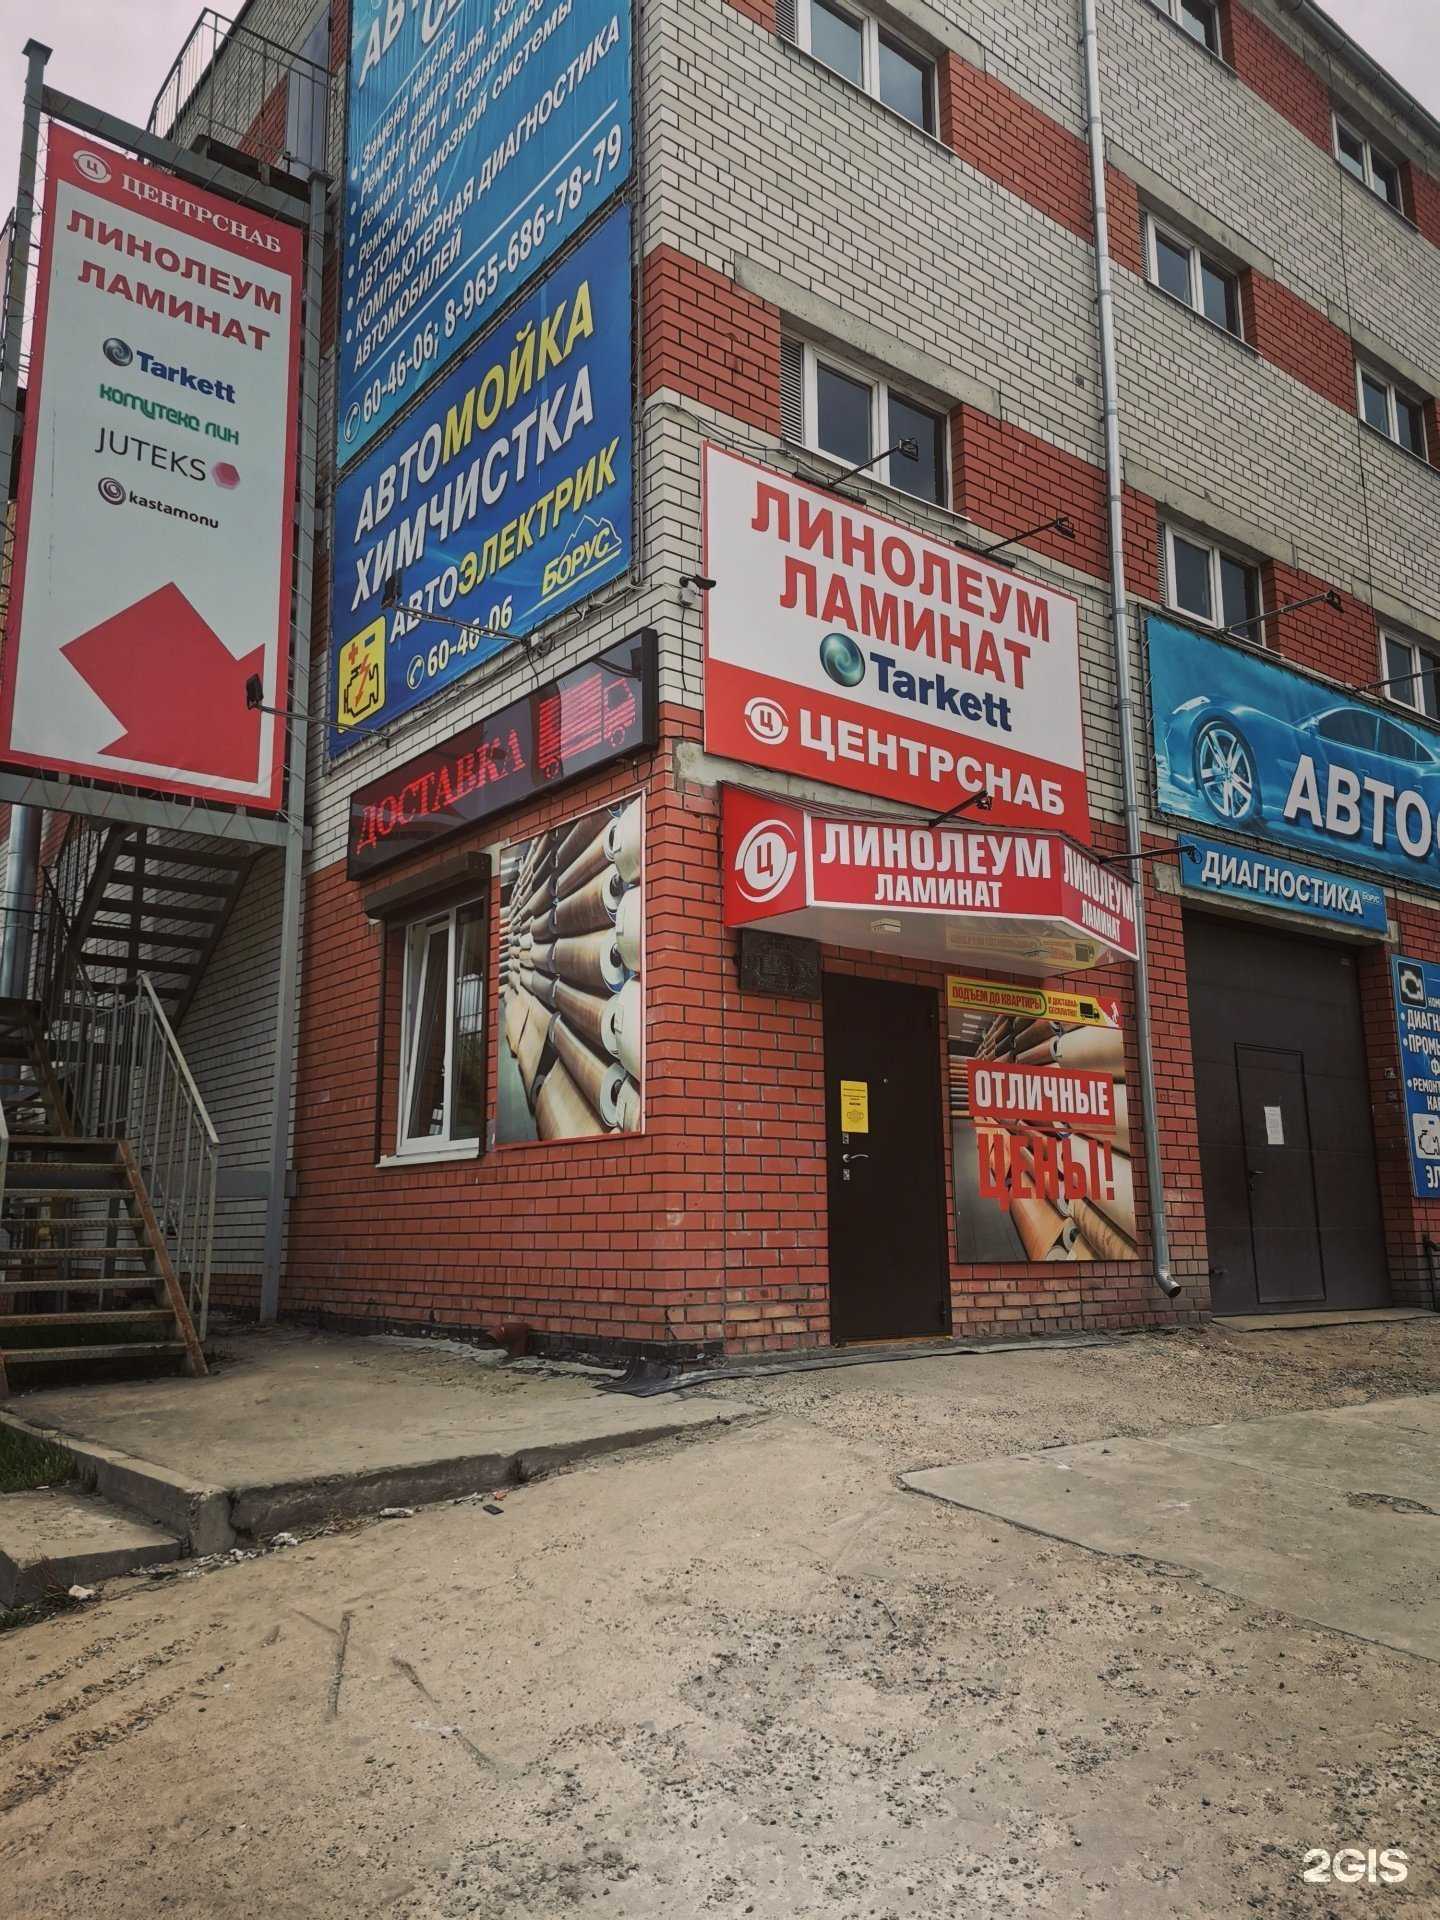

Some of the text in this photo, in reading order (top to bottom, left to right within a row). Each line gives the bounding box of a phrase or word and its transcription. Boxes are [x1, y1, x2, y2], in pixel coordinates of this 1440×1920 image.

[413, 30, 456, 101] масла
[358, 198, 404, 271] Ремонт
[408, 88, 487, 204] тормозной
[492, 0, 573, 99] системы
[361, 129, 407, 204] Ремонт
[409, 26, 487, 142] двигателя,
[356, 15, 620, 337] КОМПЬЮТЕРНАЯ ДИАГНОСТИКА
[360, 163, 405, 237] Ремонт
[409, 114, 437, 172] КПП
[440, 104, 450, 128] и
[121, 173, 281, 253] ЦЕНТРСНАБ
[356, 184, 438, 304] АВТОМОЙКА
[67, 210, 282, 315] ЛИНОЛЕУМ
[354, 224, 462, 373] АВТОМОБИЛЕЙ
[364, 124, 622, 422] 60-46-06; 8-965-686-78-79
[78, 260, 270, 351] ЛАМИНАТ
[136, 350, 236, 404] Tarkett
[354, 279, 595, 543] АВТОМОЙКА
[95, 427, 207, 482] JUTEKS
[351, 364, 594, 611] ХИМЧИСТКА
[128, 490, 219, 529] kastamonu
[389, 436, 620, 645] АВТОЭЛЕКТРИК
[541, 527, 611, 597] БОРУС
[751, 480, 1050, 643] ЛИНОЛЕУМ
[427, 596, 513, 676] 60-46-06
[779, 555, 1031, 690] ЛАМИНАТ
[870, 652, 1012, 732] Tarkett
[800, 709, 1065, 816] ЦЕНТРСНАБ
[1283, 754, 1440, 857] АВТО
[821, 823, 1051, 879] ЛИНОЛЕУМ
[875, 873, 1002, 908] ЛАМИНАТ
[1064, 844, 1134, 923] ЛИНОЛЕУМ
[1202, 851, 1364, 915] ДИАГНОСТИКА
[1082, 899, 1120, 943] ЛАМИНАТ
[952, 985, 1042, 1010] ПОДЪЕМ ДО КВАРТИРЫ
[1408, 1009, 1440, 1031] ДИАГН
[975, 1070, 1110, 1116] ОТЛИЧНЫЕ
[978, 1133, 1115, 1213] ЦЕНЫ!
